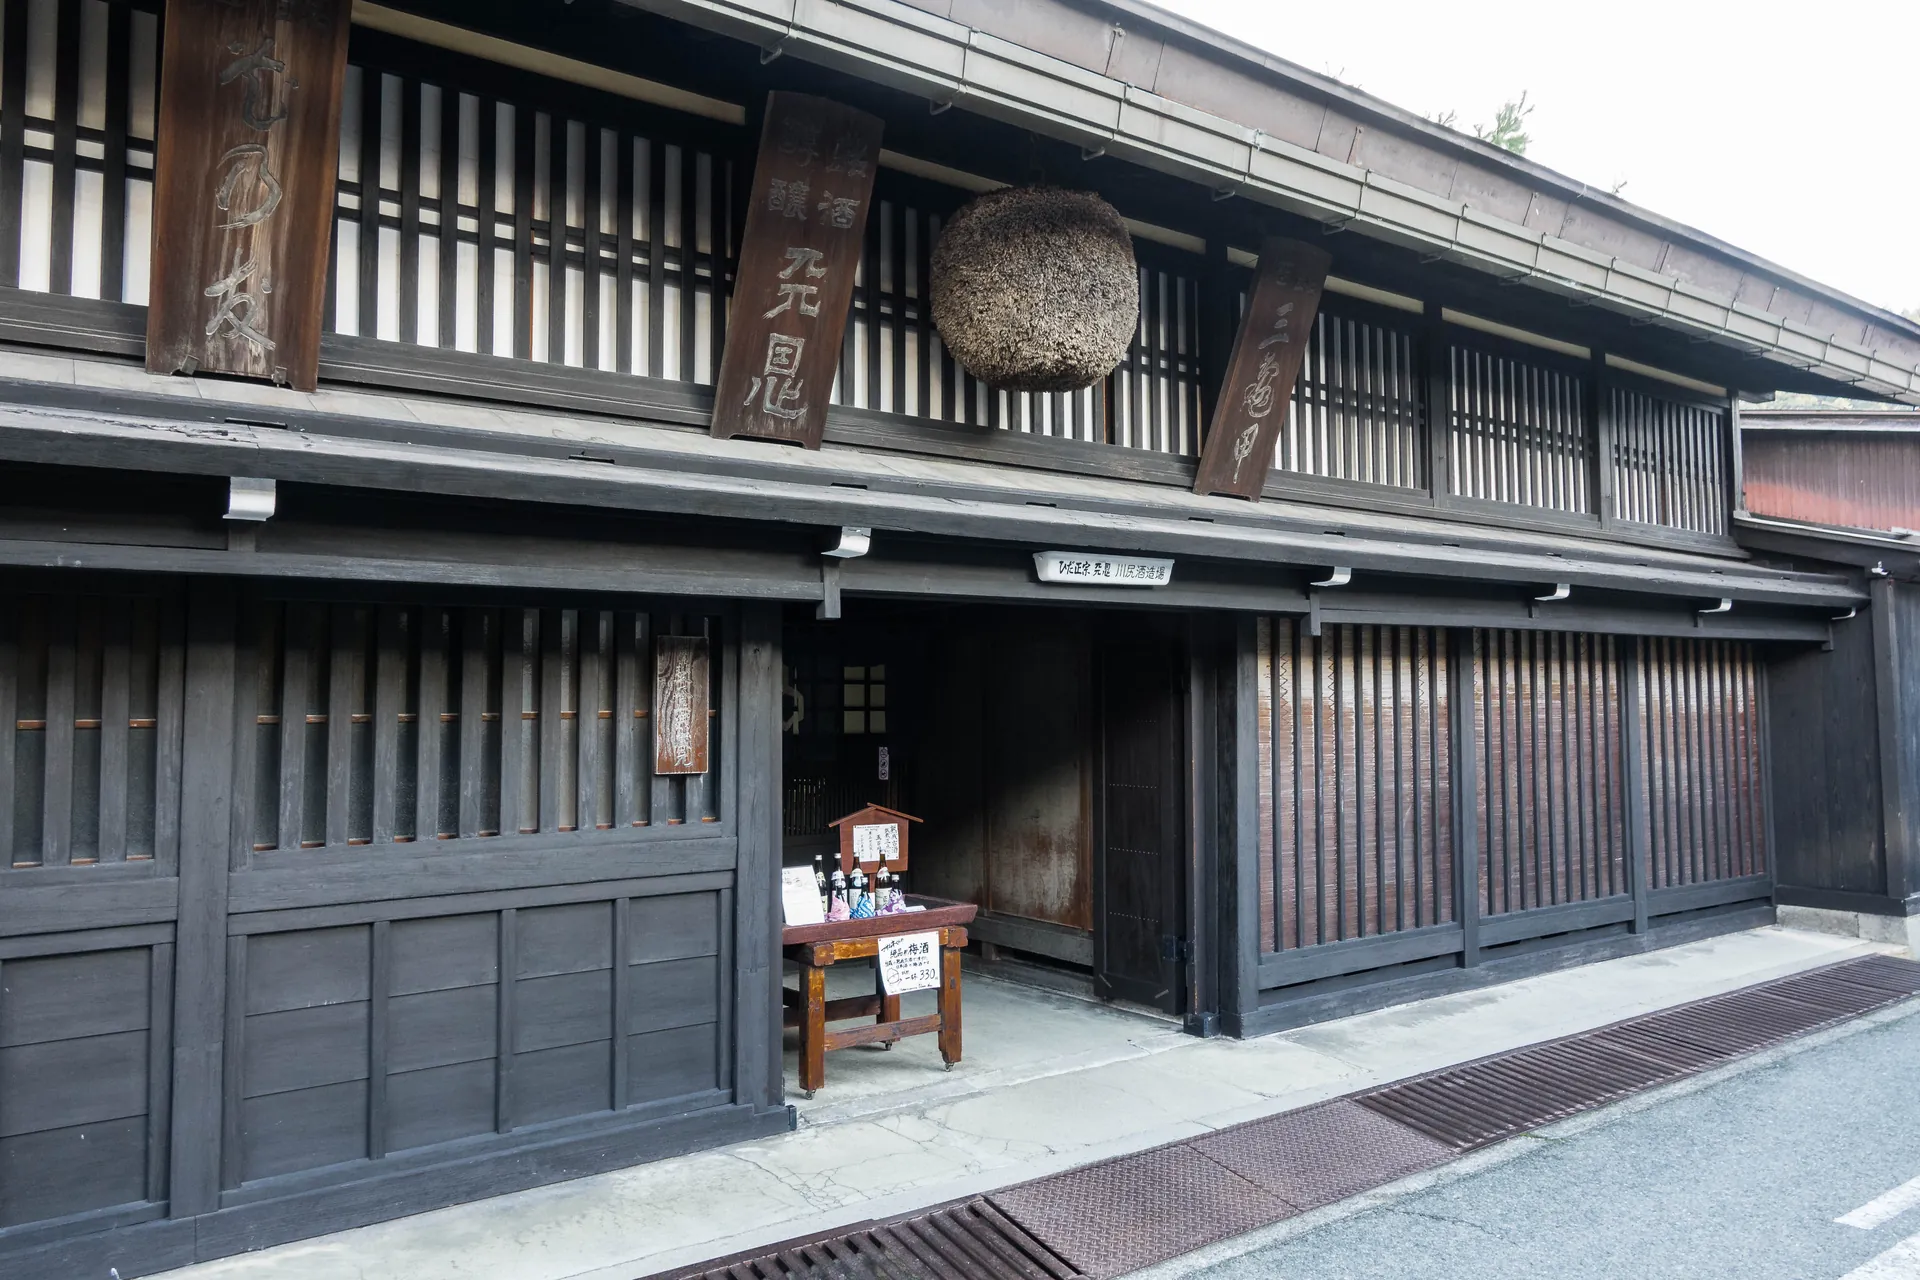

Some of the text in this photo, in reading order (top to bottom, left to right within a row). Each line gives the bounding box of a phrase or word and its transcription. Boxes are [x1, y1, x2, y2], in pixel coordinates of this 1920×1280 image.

[1059, 560, 1091, 576] ひだ正宗
[1115, 563, 1166, 581] 川尻酒造場
